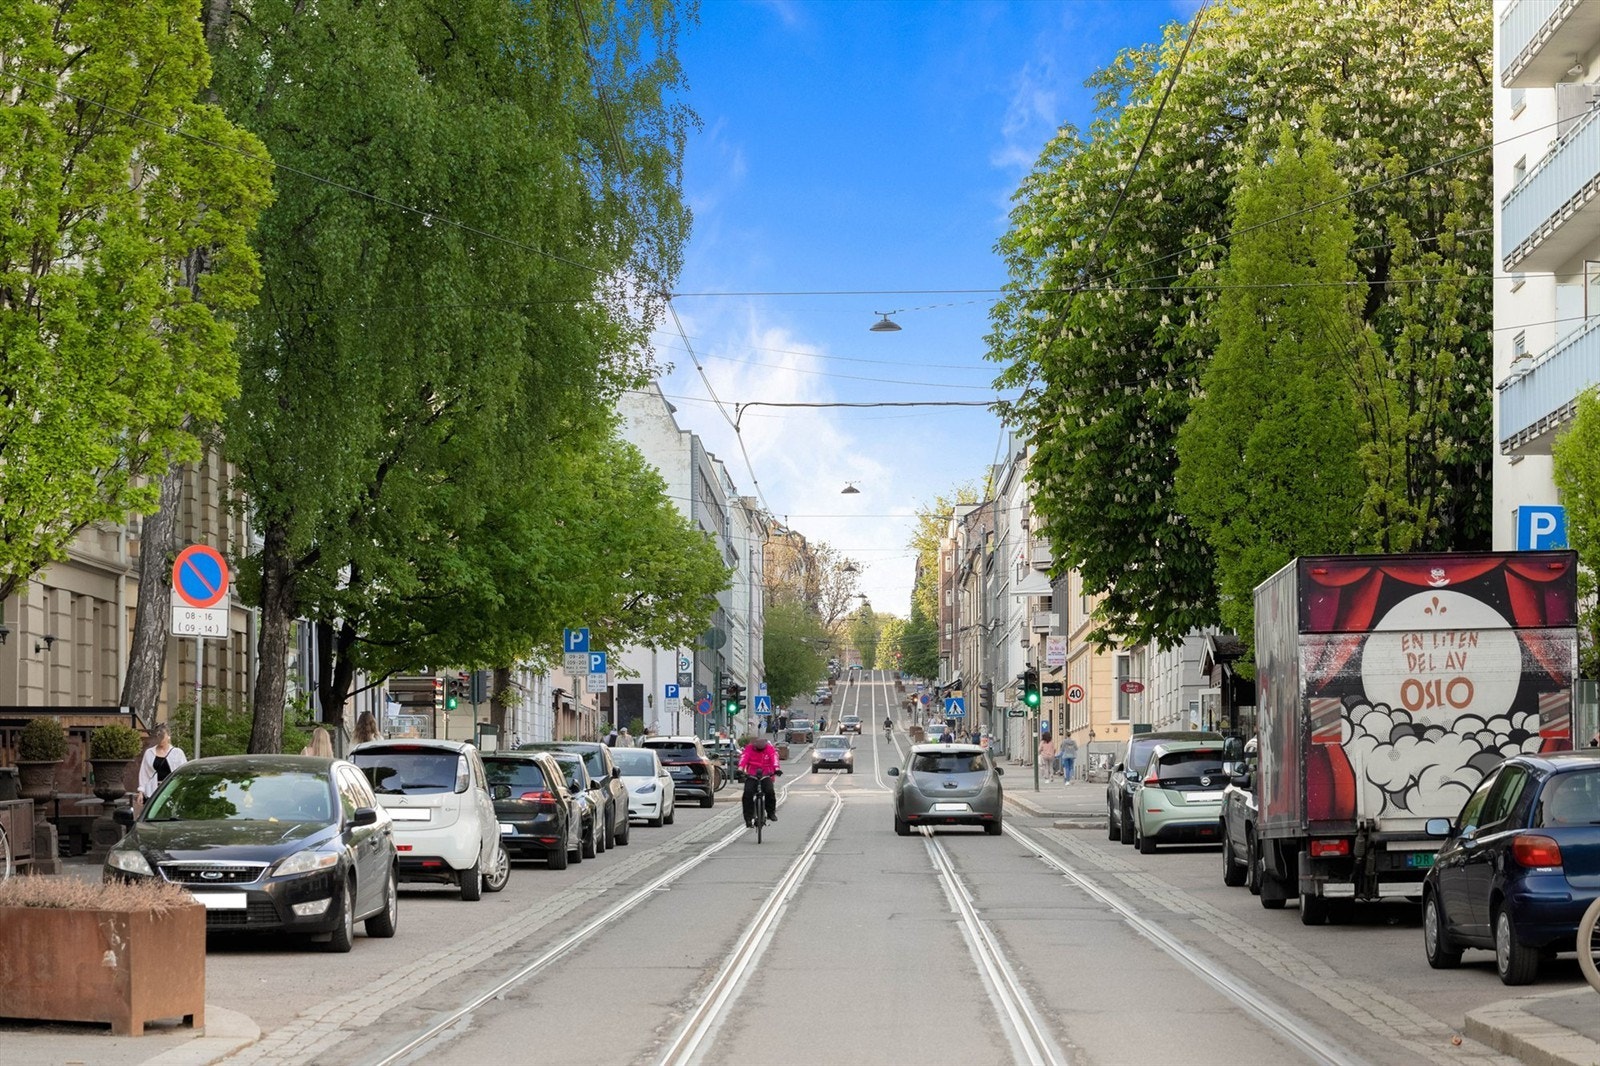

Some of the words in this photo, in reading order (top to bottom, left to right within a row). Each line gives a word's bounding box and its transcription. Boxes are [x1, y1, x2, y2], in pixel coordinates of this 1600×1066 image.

[1530, 512, 1557, 550] P
[185, 611, 196, 620] 08
[205, 613, 213, 621] 16
[570, 631, 583, 650] P
[1401, 632, 1424, 652] EN
[591, 654, 602, 671] P
[1406, 652, 1437, 674] DEL
[1445, 651, 1468, 671] AV
[668, 686, 676, 697] P
[1069, 689, 1082, 699] 40
[1401, 677, 1474, 711] OSLO
